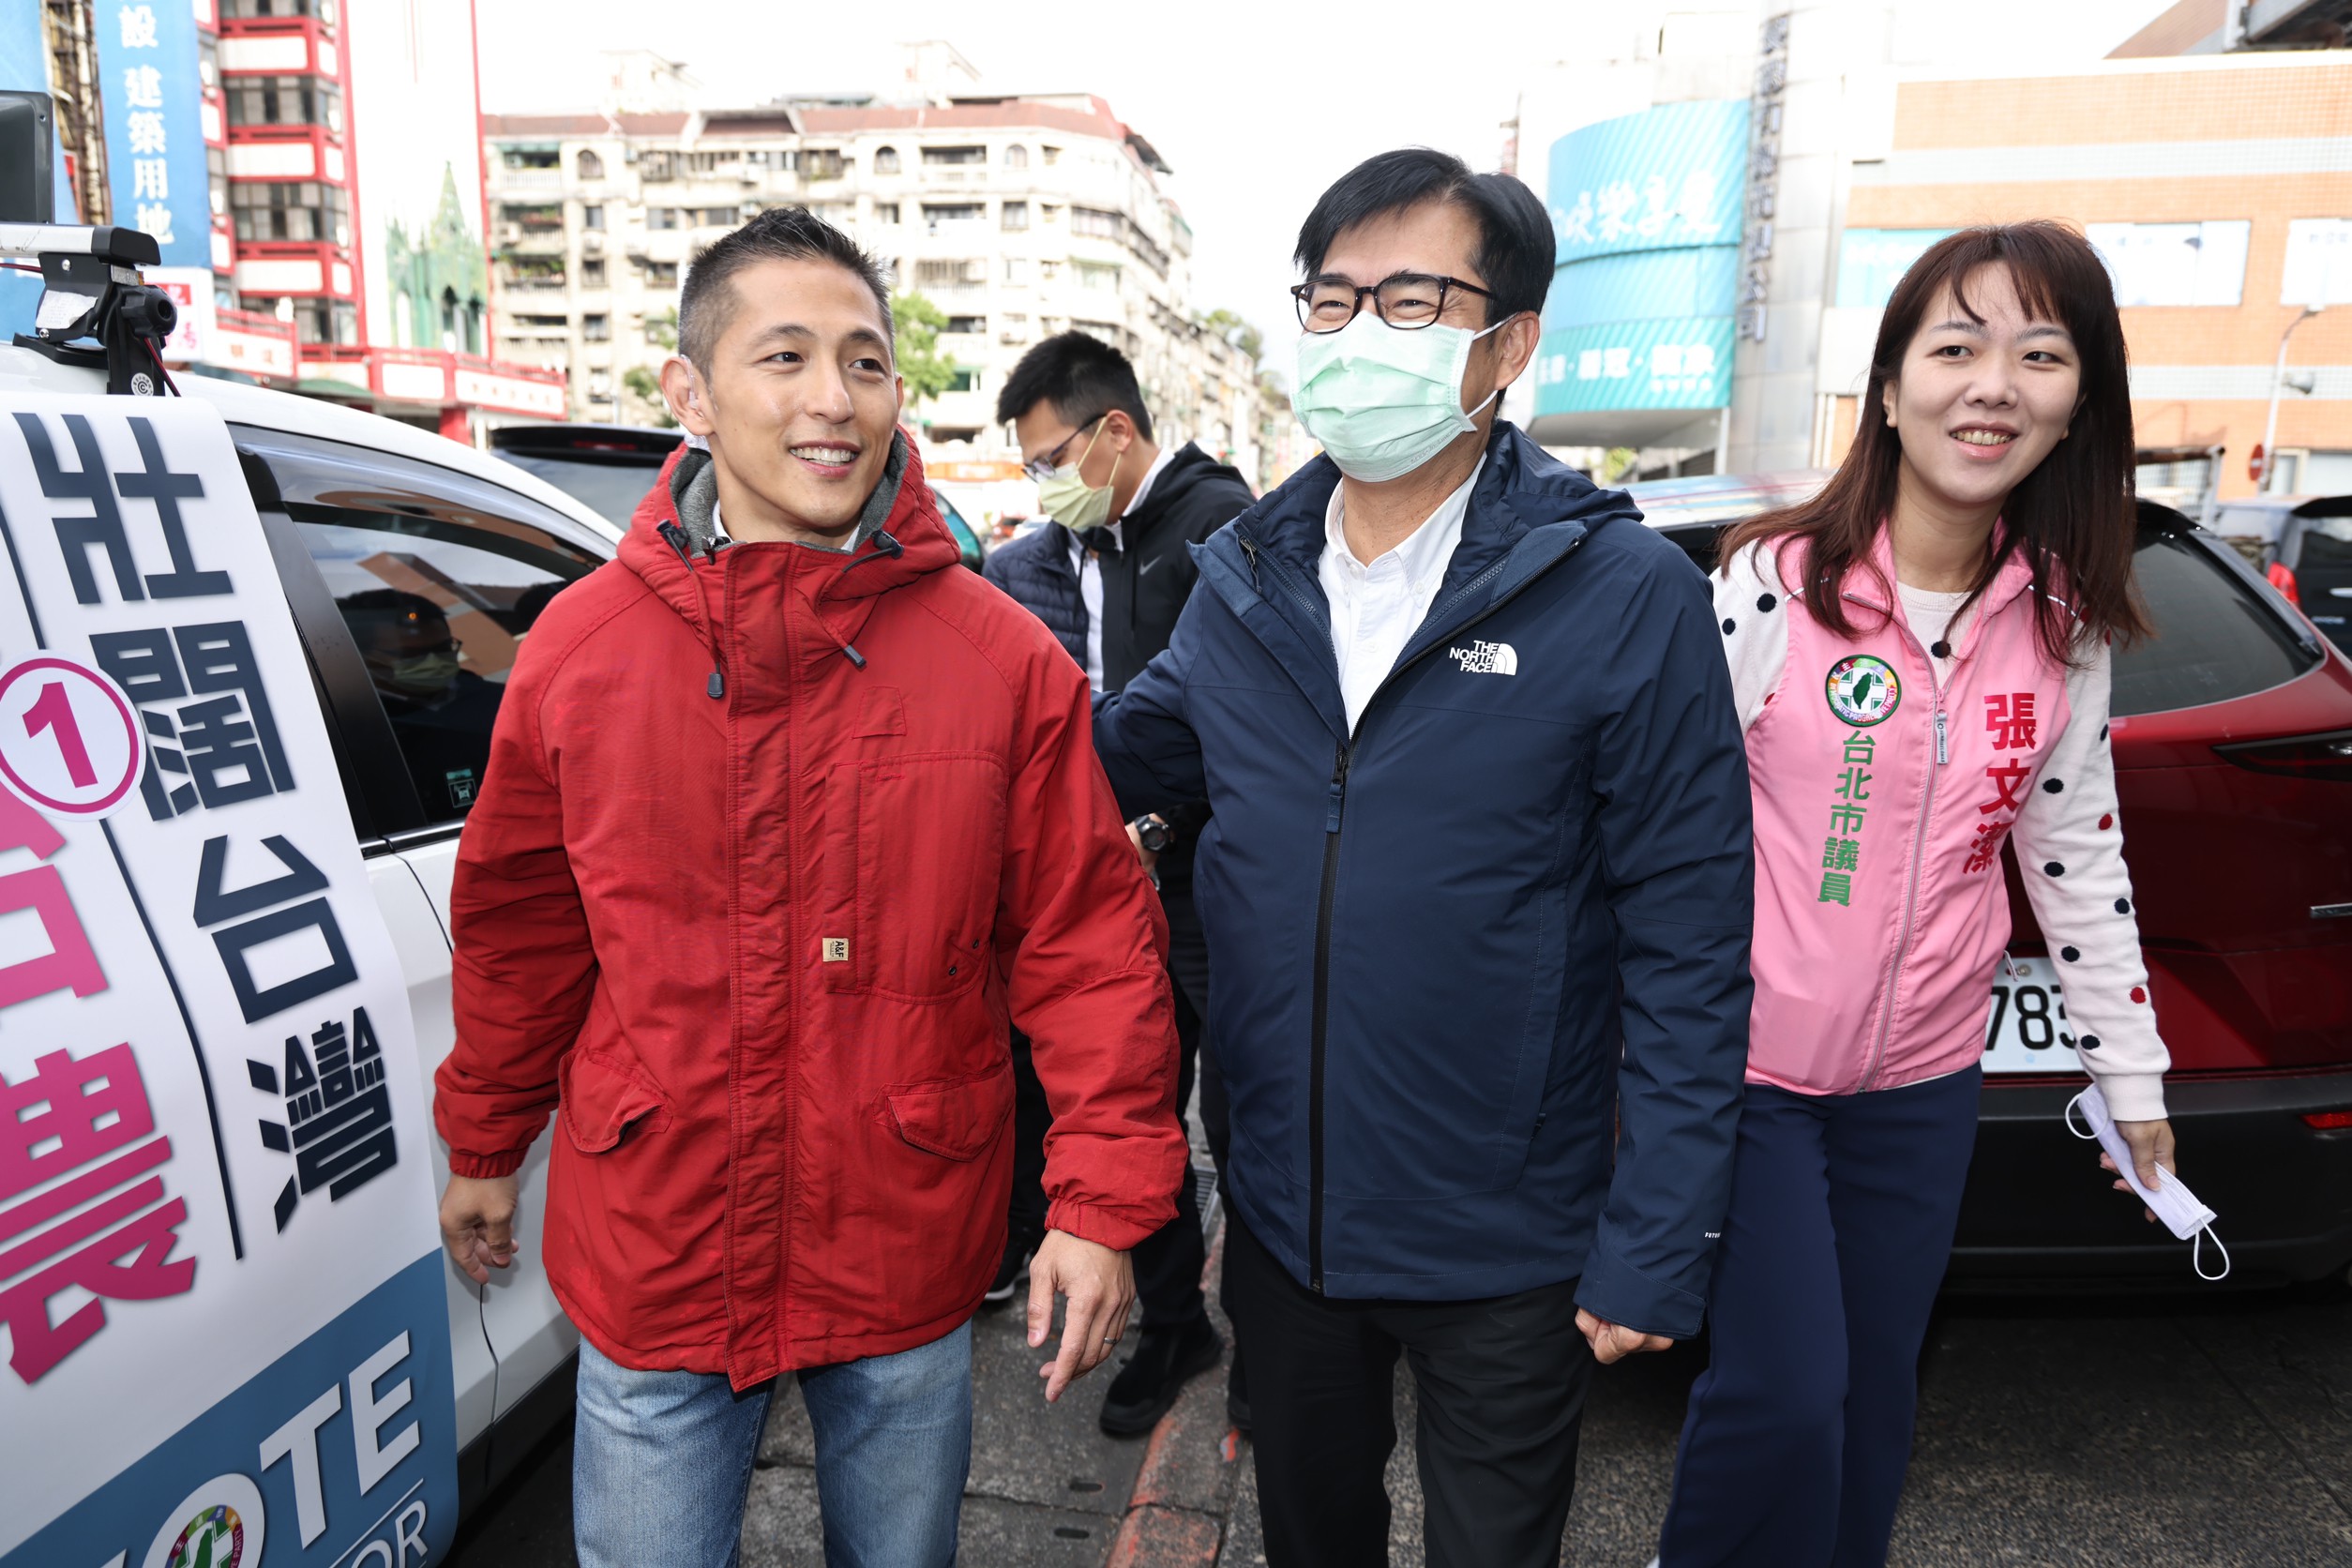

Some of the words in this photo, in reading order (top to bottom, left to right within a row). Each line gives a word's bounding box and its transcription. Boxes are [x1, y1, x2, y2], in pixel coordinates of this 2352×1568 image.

[123, 64, 175, 245] 建築用地
[1449, 647, 1496, 663] NORTH
[1473, 640, 1500, 654] THE
[1460, 660, 1492, 673] FACE
[23, 682, 98, 788] 1
[11, 413, 398, 1235] 壯闊台灣
[1817, 730, 1877, 907] 台北市議員
[835, 941, 844, 957] A&F
[234, 1529, 242, 1558] PARTY
